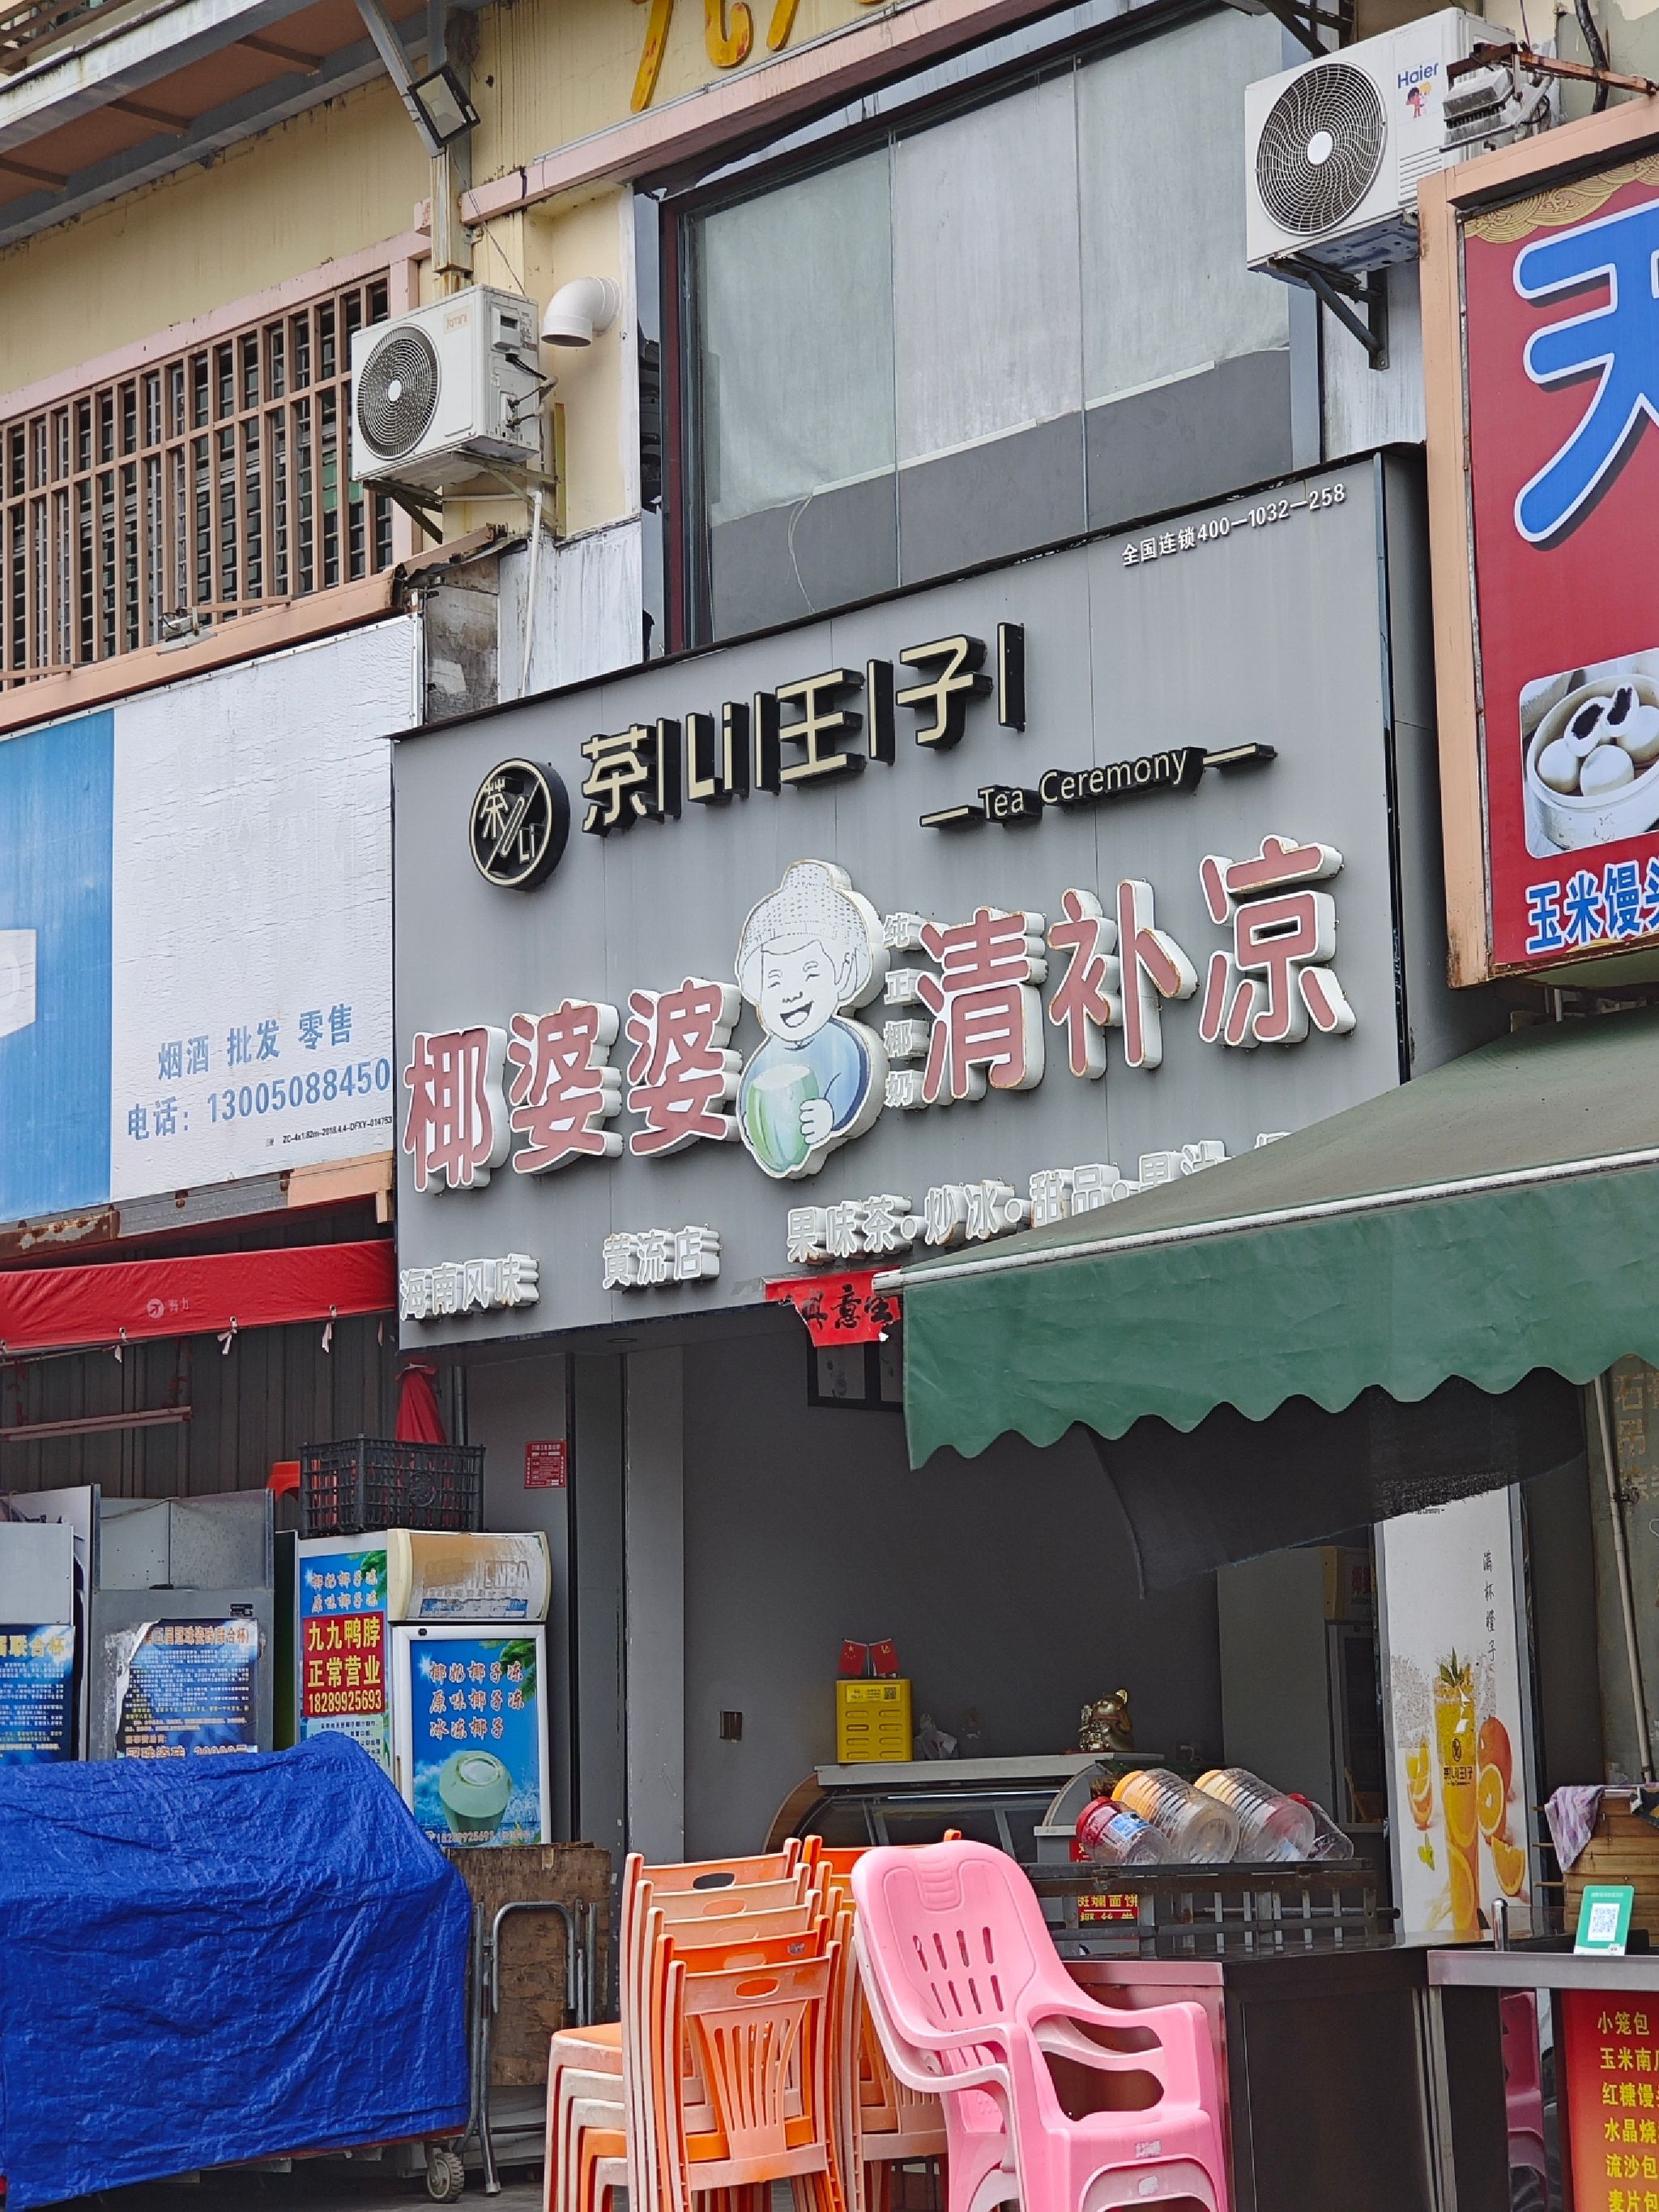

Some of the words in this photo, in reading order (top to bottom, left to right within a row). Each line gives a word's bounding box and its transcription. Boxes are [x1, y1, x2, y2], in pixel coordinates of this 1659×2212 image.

[1397, 62, 1439, 89] Haier
[979, 784, 1026, 820] Tea
[1039, 747, 1189, 805] Ceremony
[403, 976, 744, 1193] 椰婆婆
[916, 835, 1355, 1104] 清补凉
[158, 1034, 210, 1080] 烟酒
[227, 1019, 281, 1067] 批发
[297, 1003, 353, 1050] 零售
[399, 1253, 538, 1321] 海南风味
[602, 1224, 718, 1290] 黄流店
[308, 1616, 381, 1651] 九九鸭脖
[307, 1655, 381, 1688] 正常营业
[309, 1689, 382, 1714] 18289925693
[429, 1688, 525, 1715] 原味椰子冻
[429, 1716, 504, 1741] 冰冻椰子
[1597, 2010, 1650, 2035] 小笼包
[1601, 2082, 1659, 2107] 红糖馒
[1606, 2153, 1658, 2179] 流沙包
